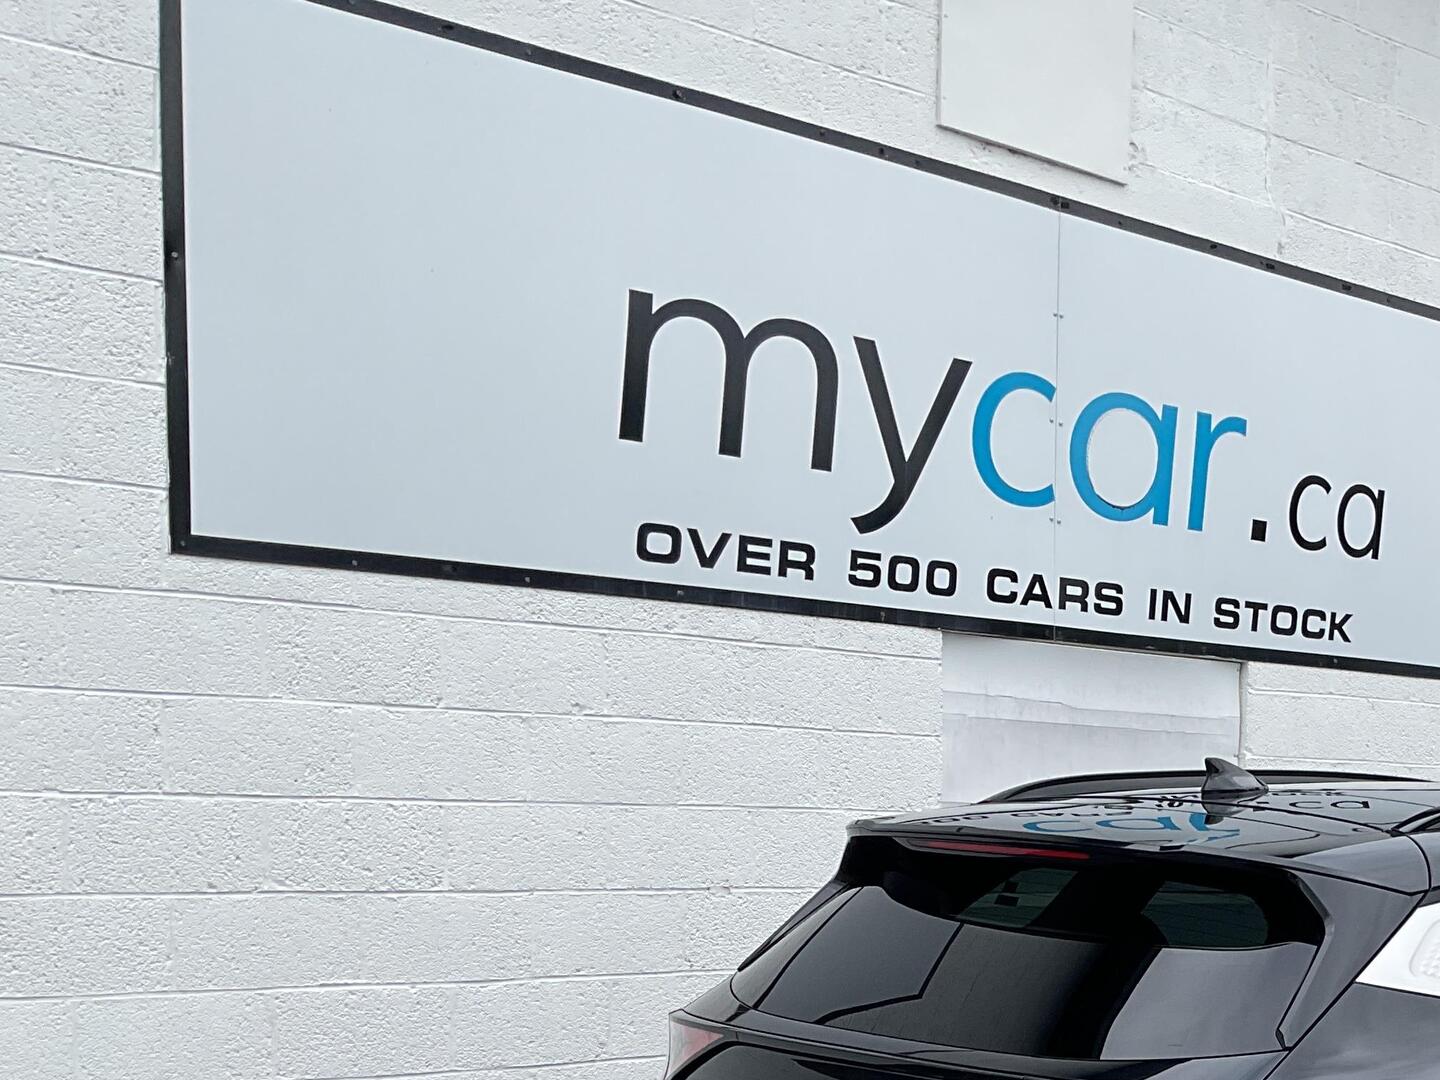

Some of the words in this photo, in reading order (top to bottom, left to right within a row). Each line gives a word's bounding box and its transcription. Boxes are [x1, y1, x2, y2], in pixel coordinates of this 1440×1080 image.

[636, 522, 816, 580] OVER
[847, 550, 959, 597] 500
[986, 567, 1126, 616] CARS
[1148, 588, 1192, 625] IN
[1213, 600, 1354, 645] STOCK
